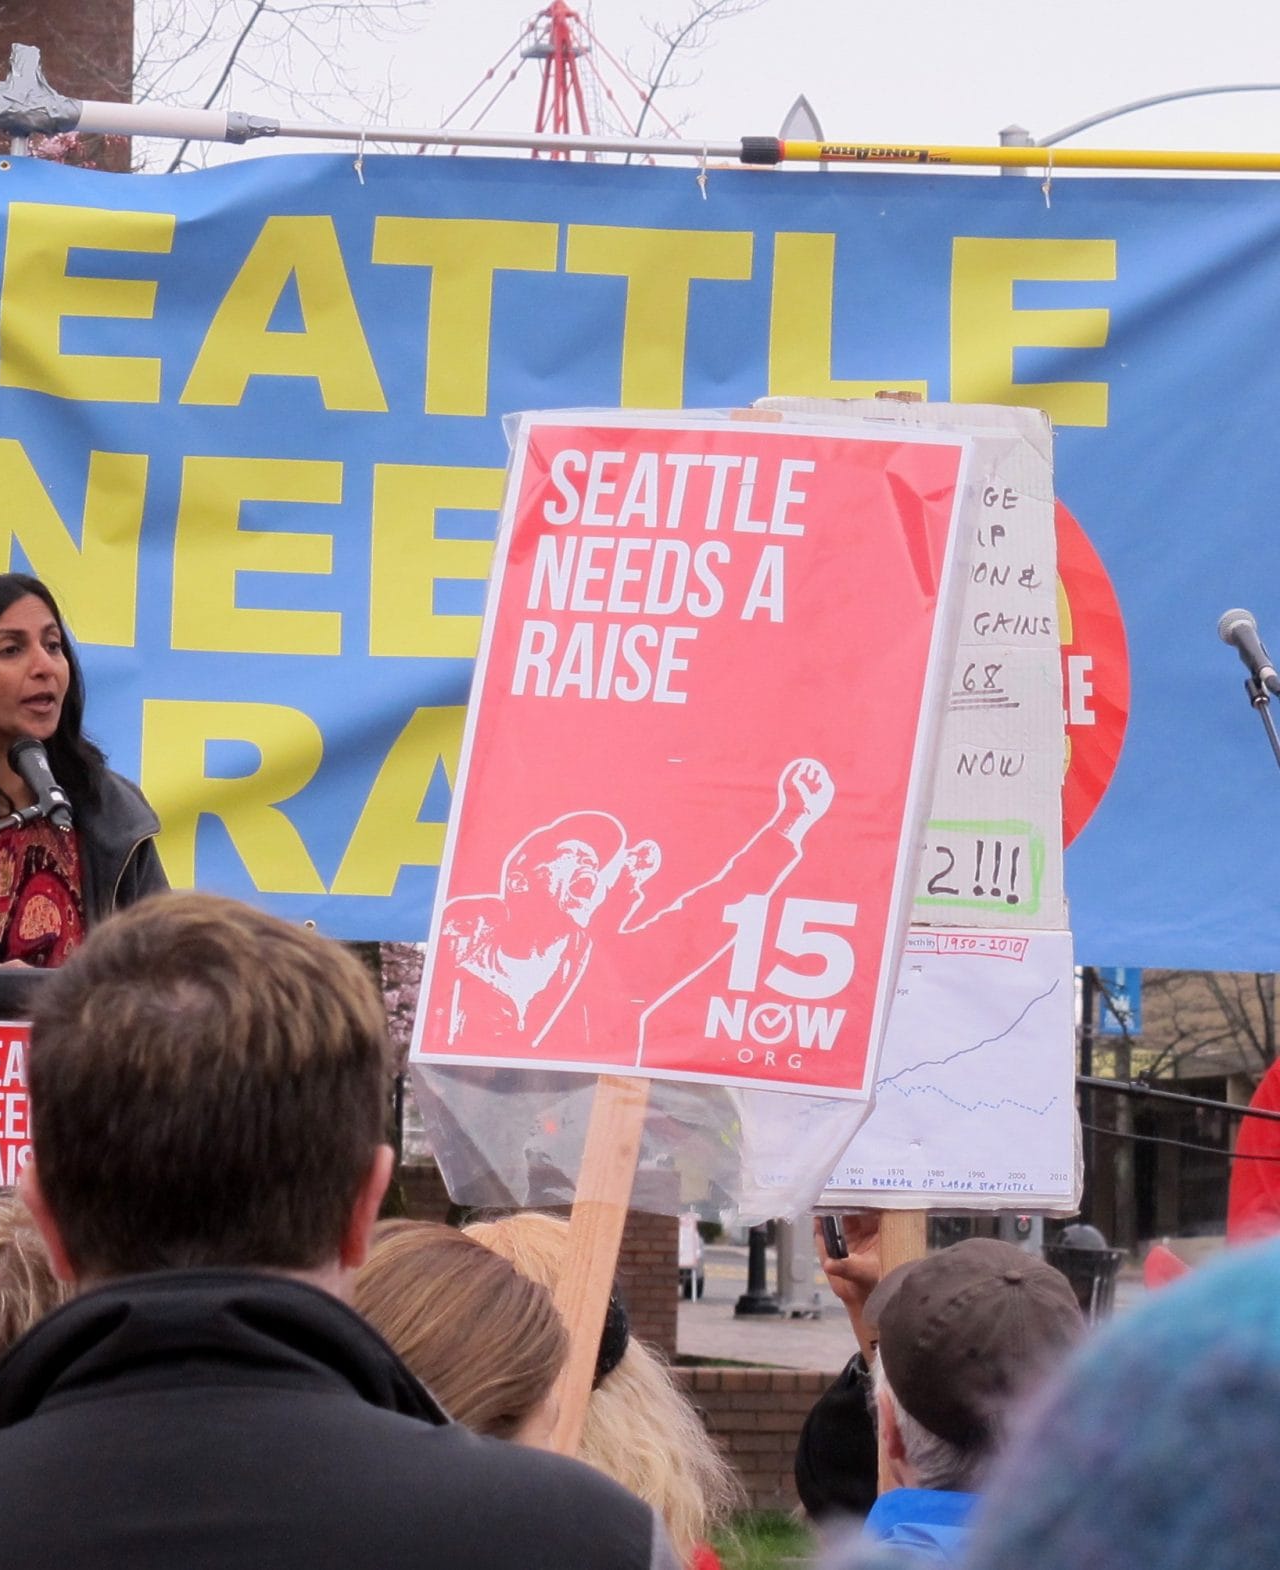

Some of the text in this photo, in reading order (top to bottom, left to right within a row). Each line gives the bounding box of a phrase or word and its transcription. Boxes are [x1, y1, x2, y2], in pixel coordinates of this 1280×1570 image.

[543, 449, 816, 536] SEATTLE
[526, 535, 785, 623] NEEDS A
[511, 620, 699, 704] RAISE
[974, 612, 1052, 636] GAINS
[957, 751, 1025, 776] NOW
[722, 893, 858, 1000] 15
[704, 996, 847, 1051] NOW
